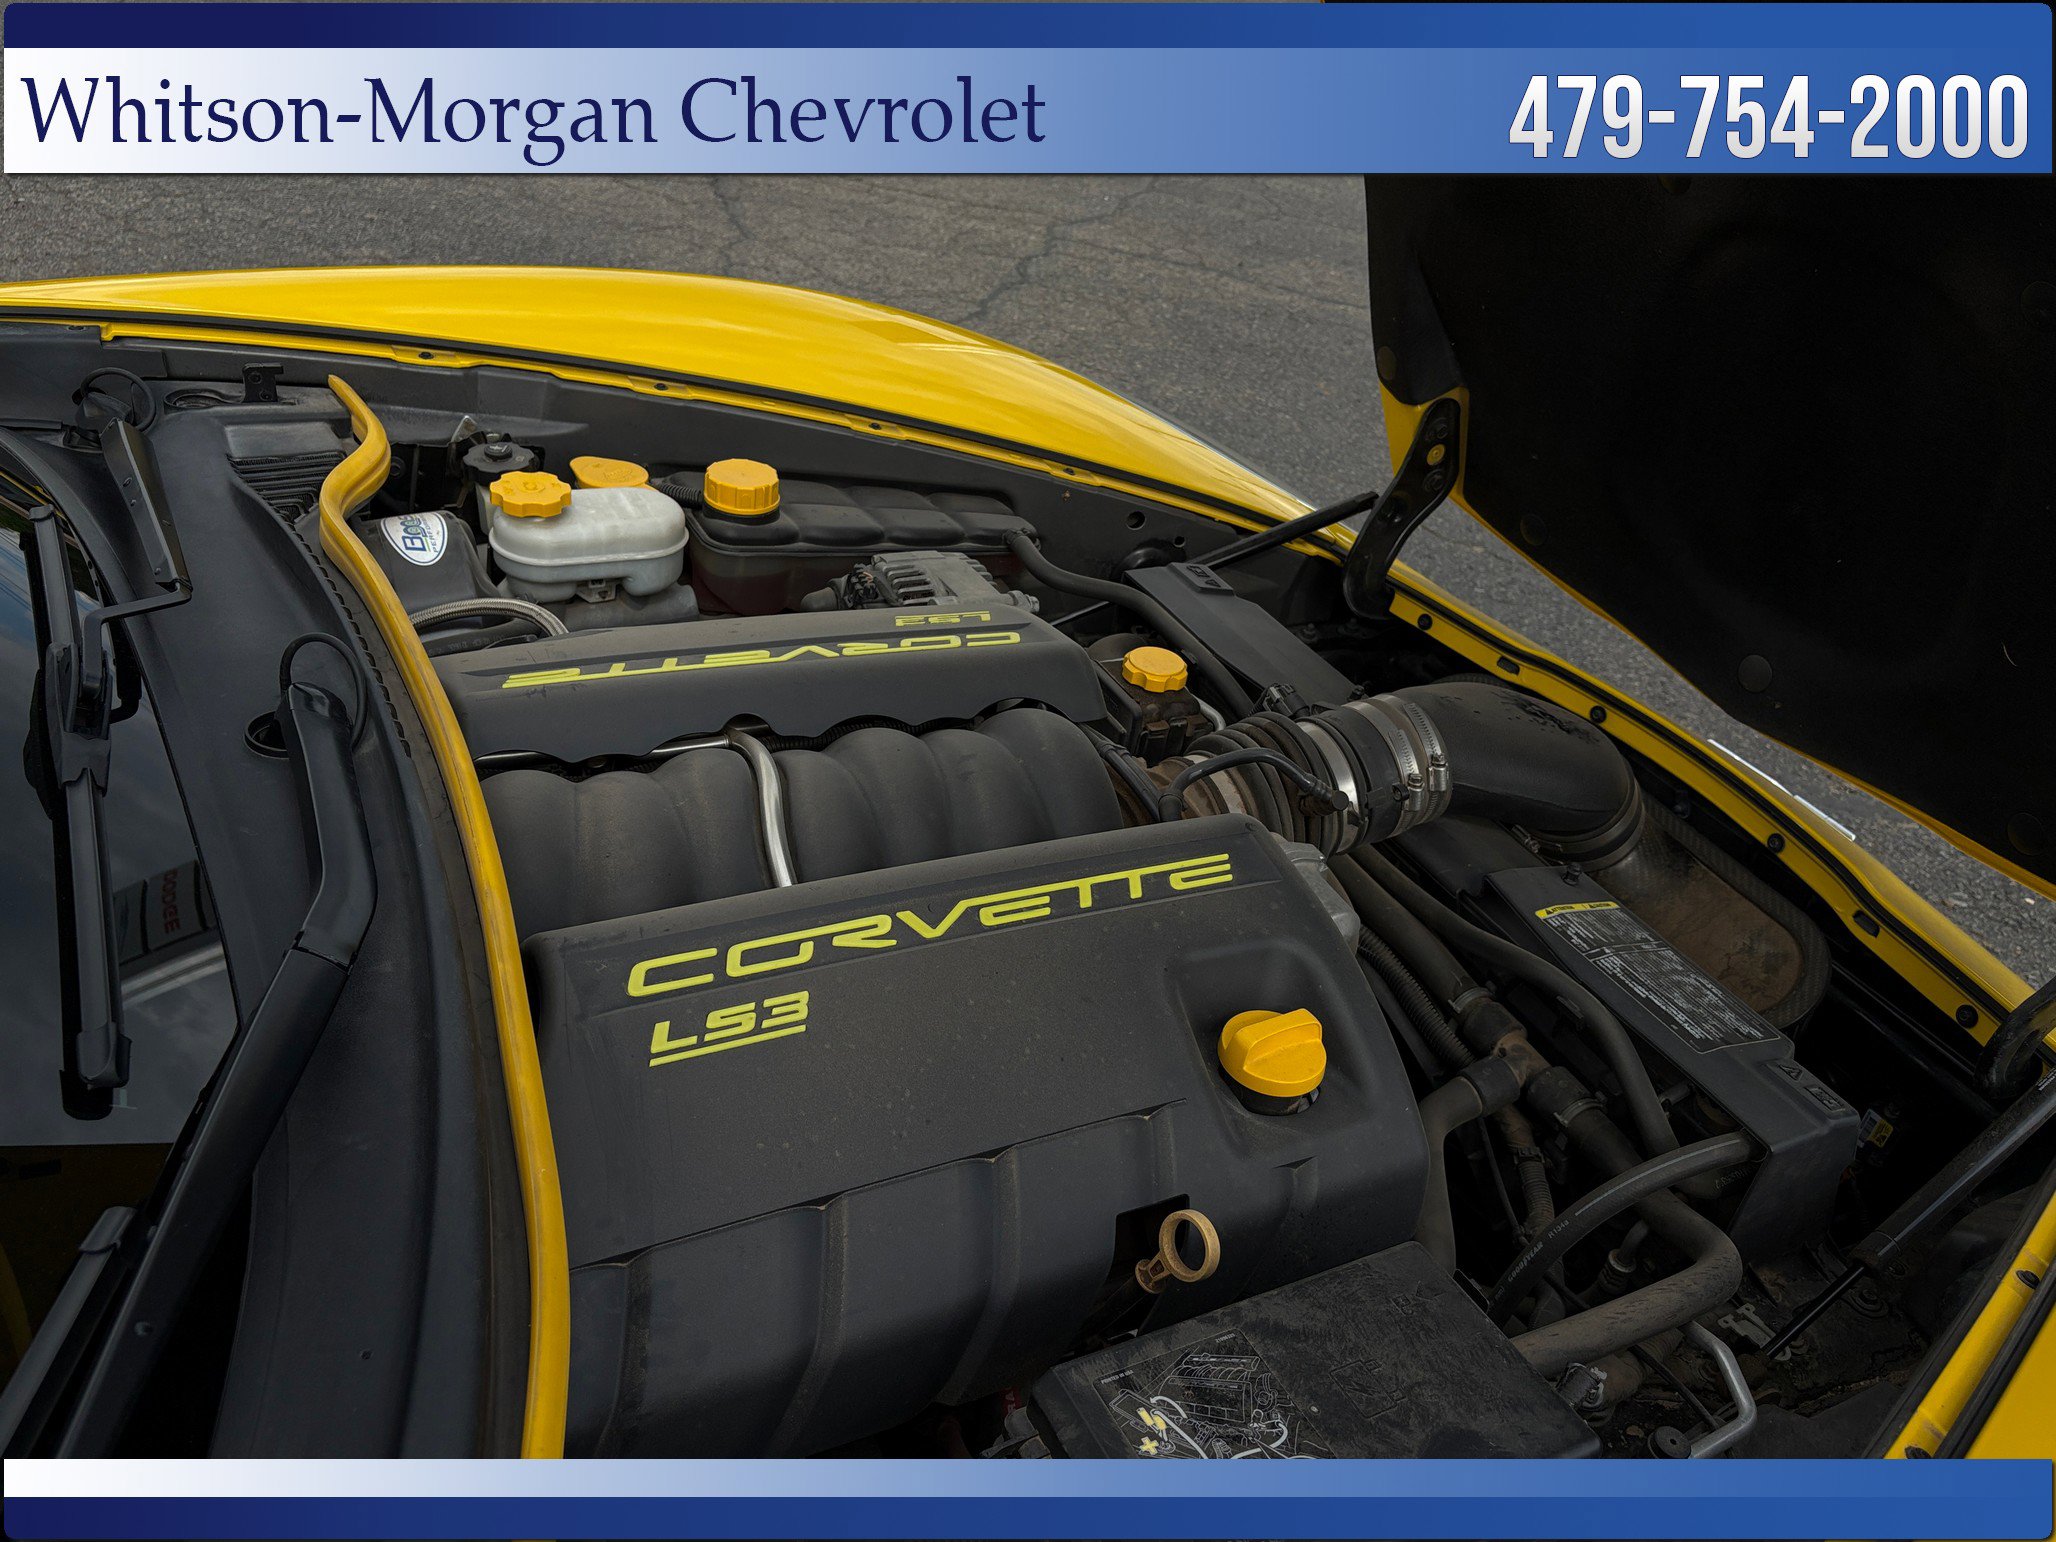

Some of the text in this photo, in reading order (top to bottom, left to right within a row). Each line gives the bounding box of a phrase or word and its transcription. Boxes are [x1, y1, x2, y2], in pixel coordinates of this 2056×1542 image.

[502, 631, 1021, 689] CORVETTE
[626, 853, 1234, 997] CORVETTE
[650, 990, 810, 1058] LS3
[1507, 1241, 1543, 1282] GOODYEAR
